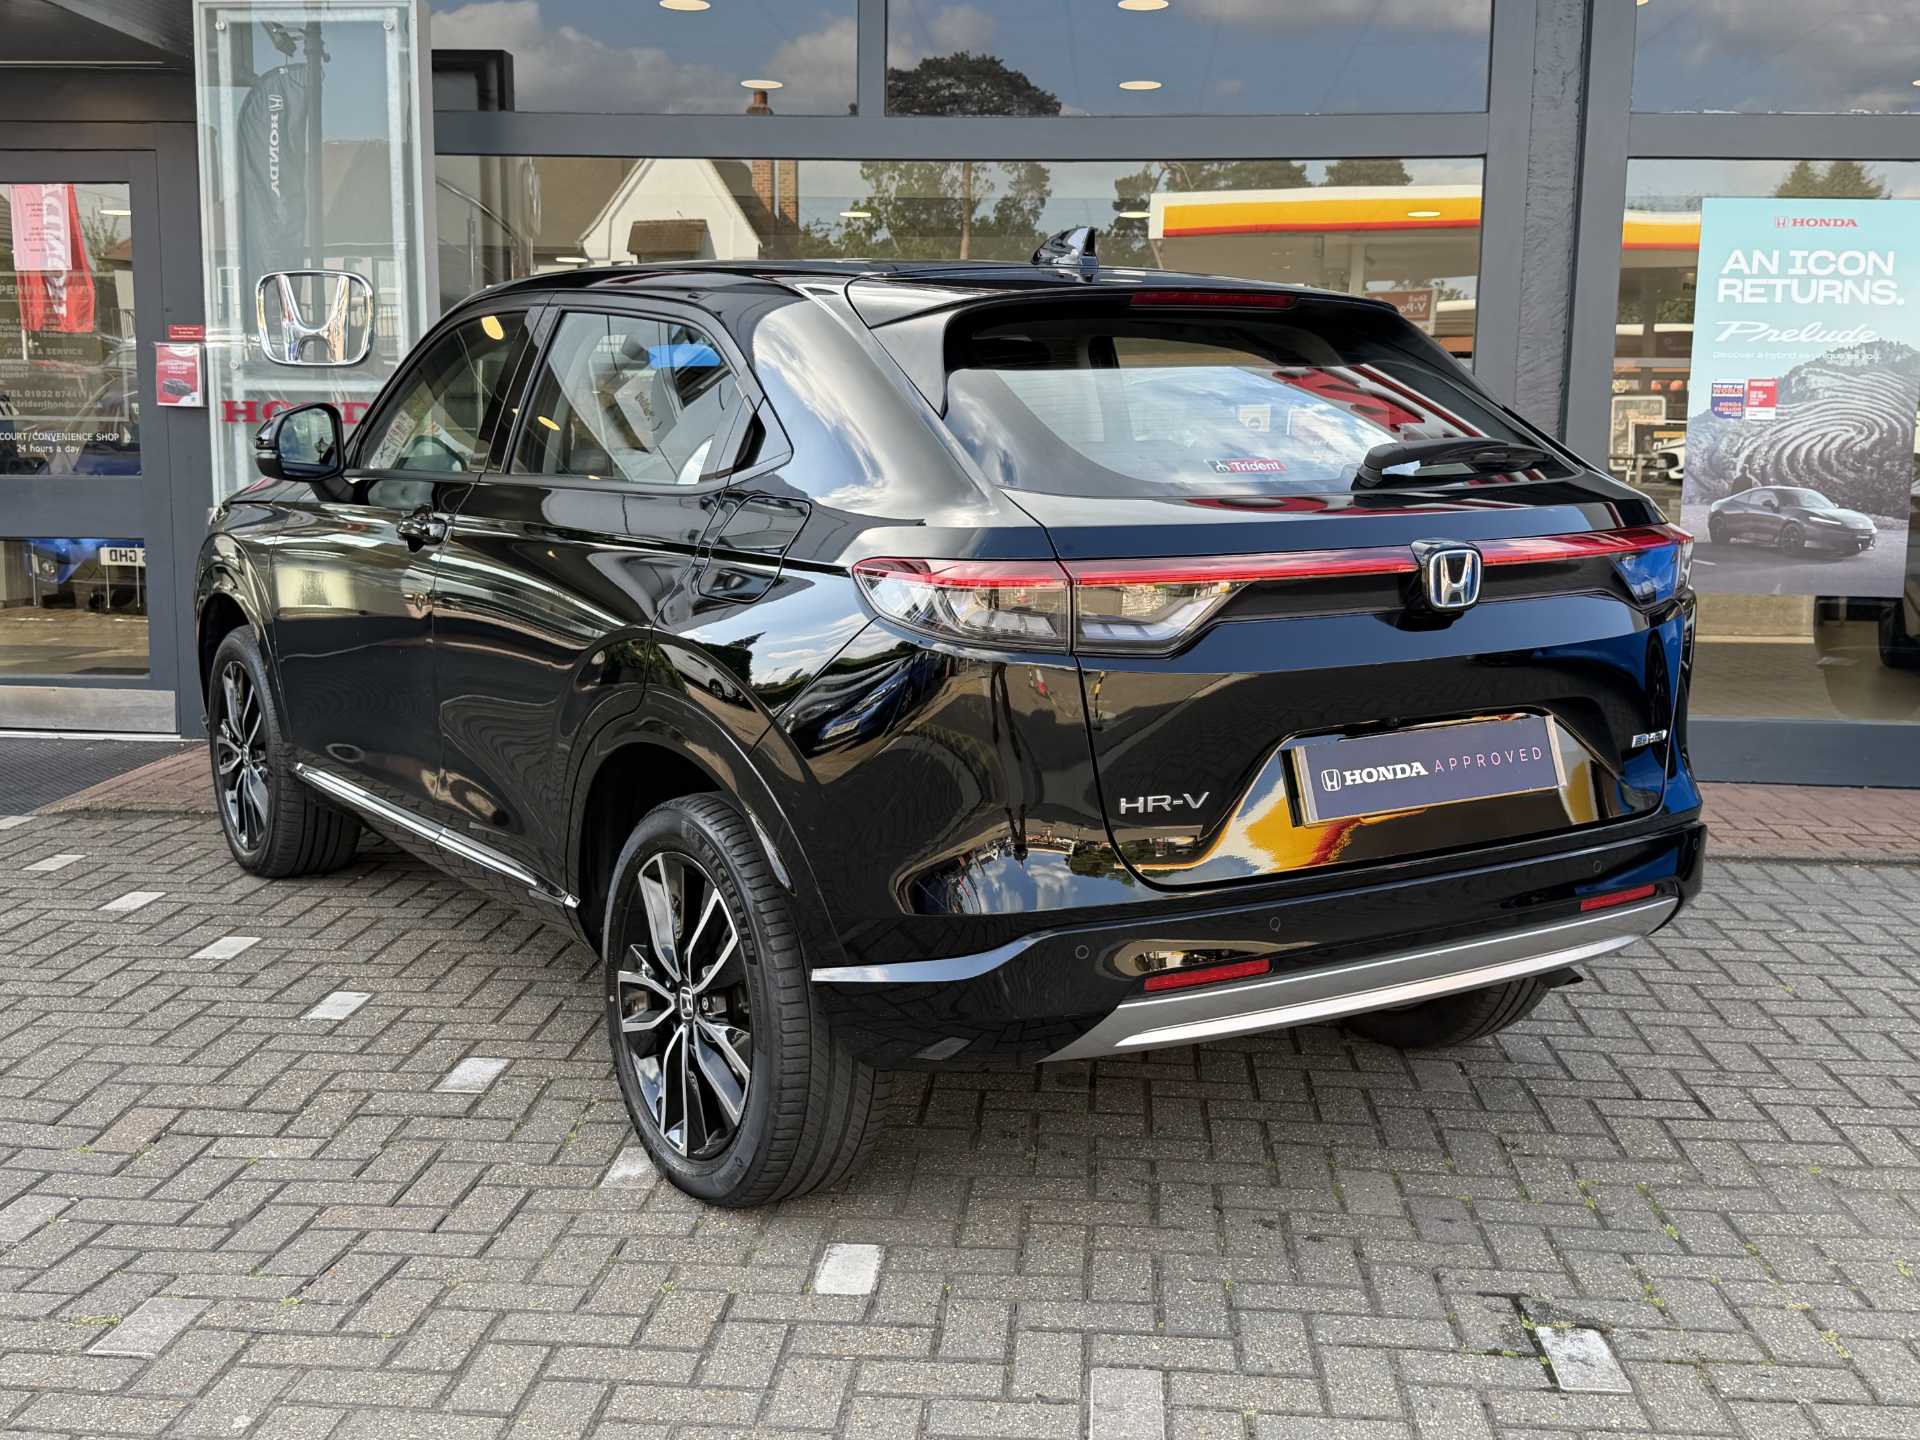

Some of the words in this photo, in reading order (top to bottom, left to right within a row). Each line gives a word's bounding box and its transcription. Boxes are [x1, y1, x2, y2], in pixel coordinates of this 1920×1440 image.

[1791, 218, 1858, 228] HONDA
[1720, 250, 1780, 275] AN
[1787, 250, 1895, 276] ICON
[1717, 278, 1905, 305] RETURNS.
[1714, 321, 1878, 343] Prelude
[96, 432, 120, 442] SHOP
[17, 444, 27, 453] 24
[29, 443, 54, 453] hours
[65, 444, 80, 456] day
[1234, 461, 1281, 472] Trident
[1343, 761, 1429, 786] HONDA
[1434, 746, 1542, 773] APPROVED
[1119, 791, 1210, 815] HR-V
